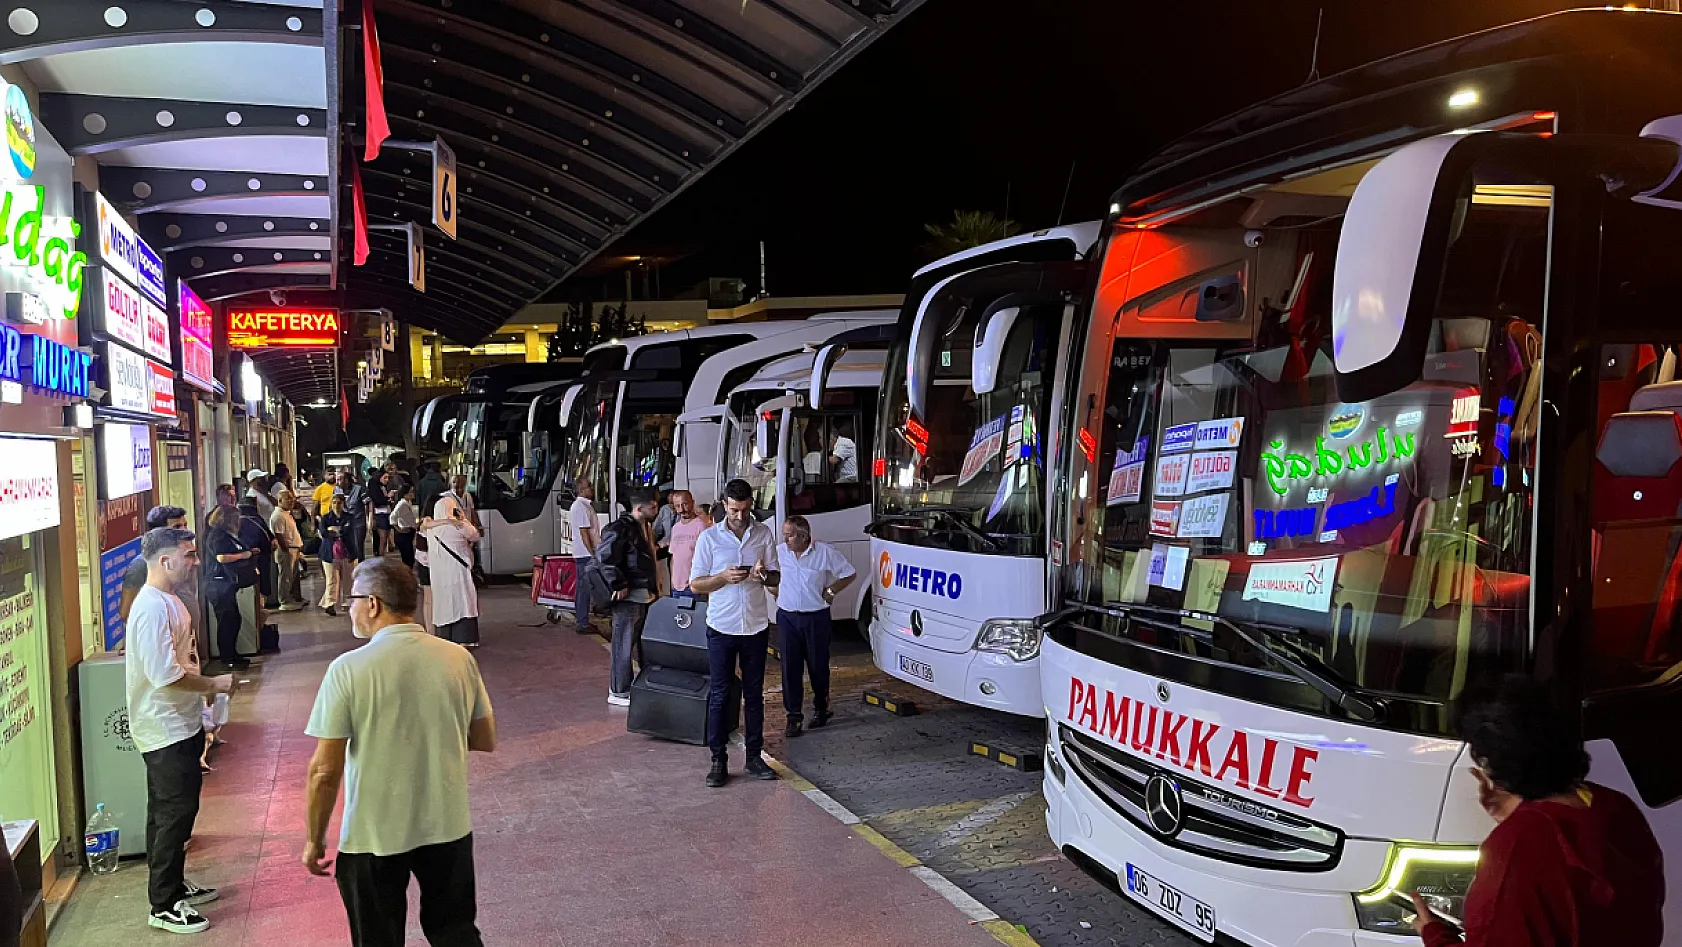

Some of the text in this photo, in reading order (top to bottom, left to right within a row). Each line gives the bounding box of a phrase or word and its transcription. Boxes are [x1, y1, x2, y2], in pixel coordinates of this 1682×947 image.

[441, 171, 452, 222] 6
[110, 221, 136, 269] METRO
[415, 244, 421, 281] 7
[230, 312, 338, 331] KAFETERYA
[385, 321, 391, 345] 8
[32, 333, 91, 398] MURAT
[894, 562, 962, 600] METRO
[1066, 676, 1320, 809] PAMUKKALE
[1202, 788, 1280, 823] TOURISMO
[1133, 868, 1149, 898] 06
[1195, 898, 1214, 932] 95
